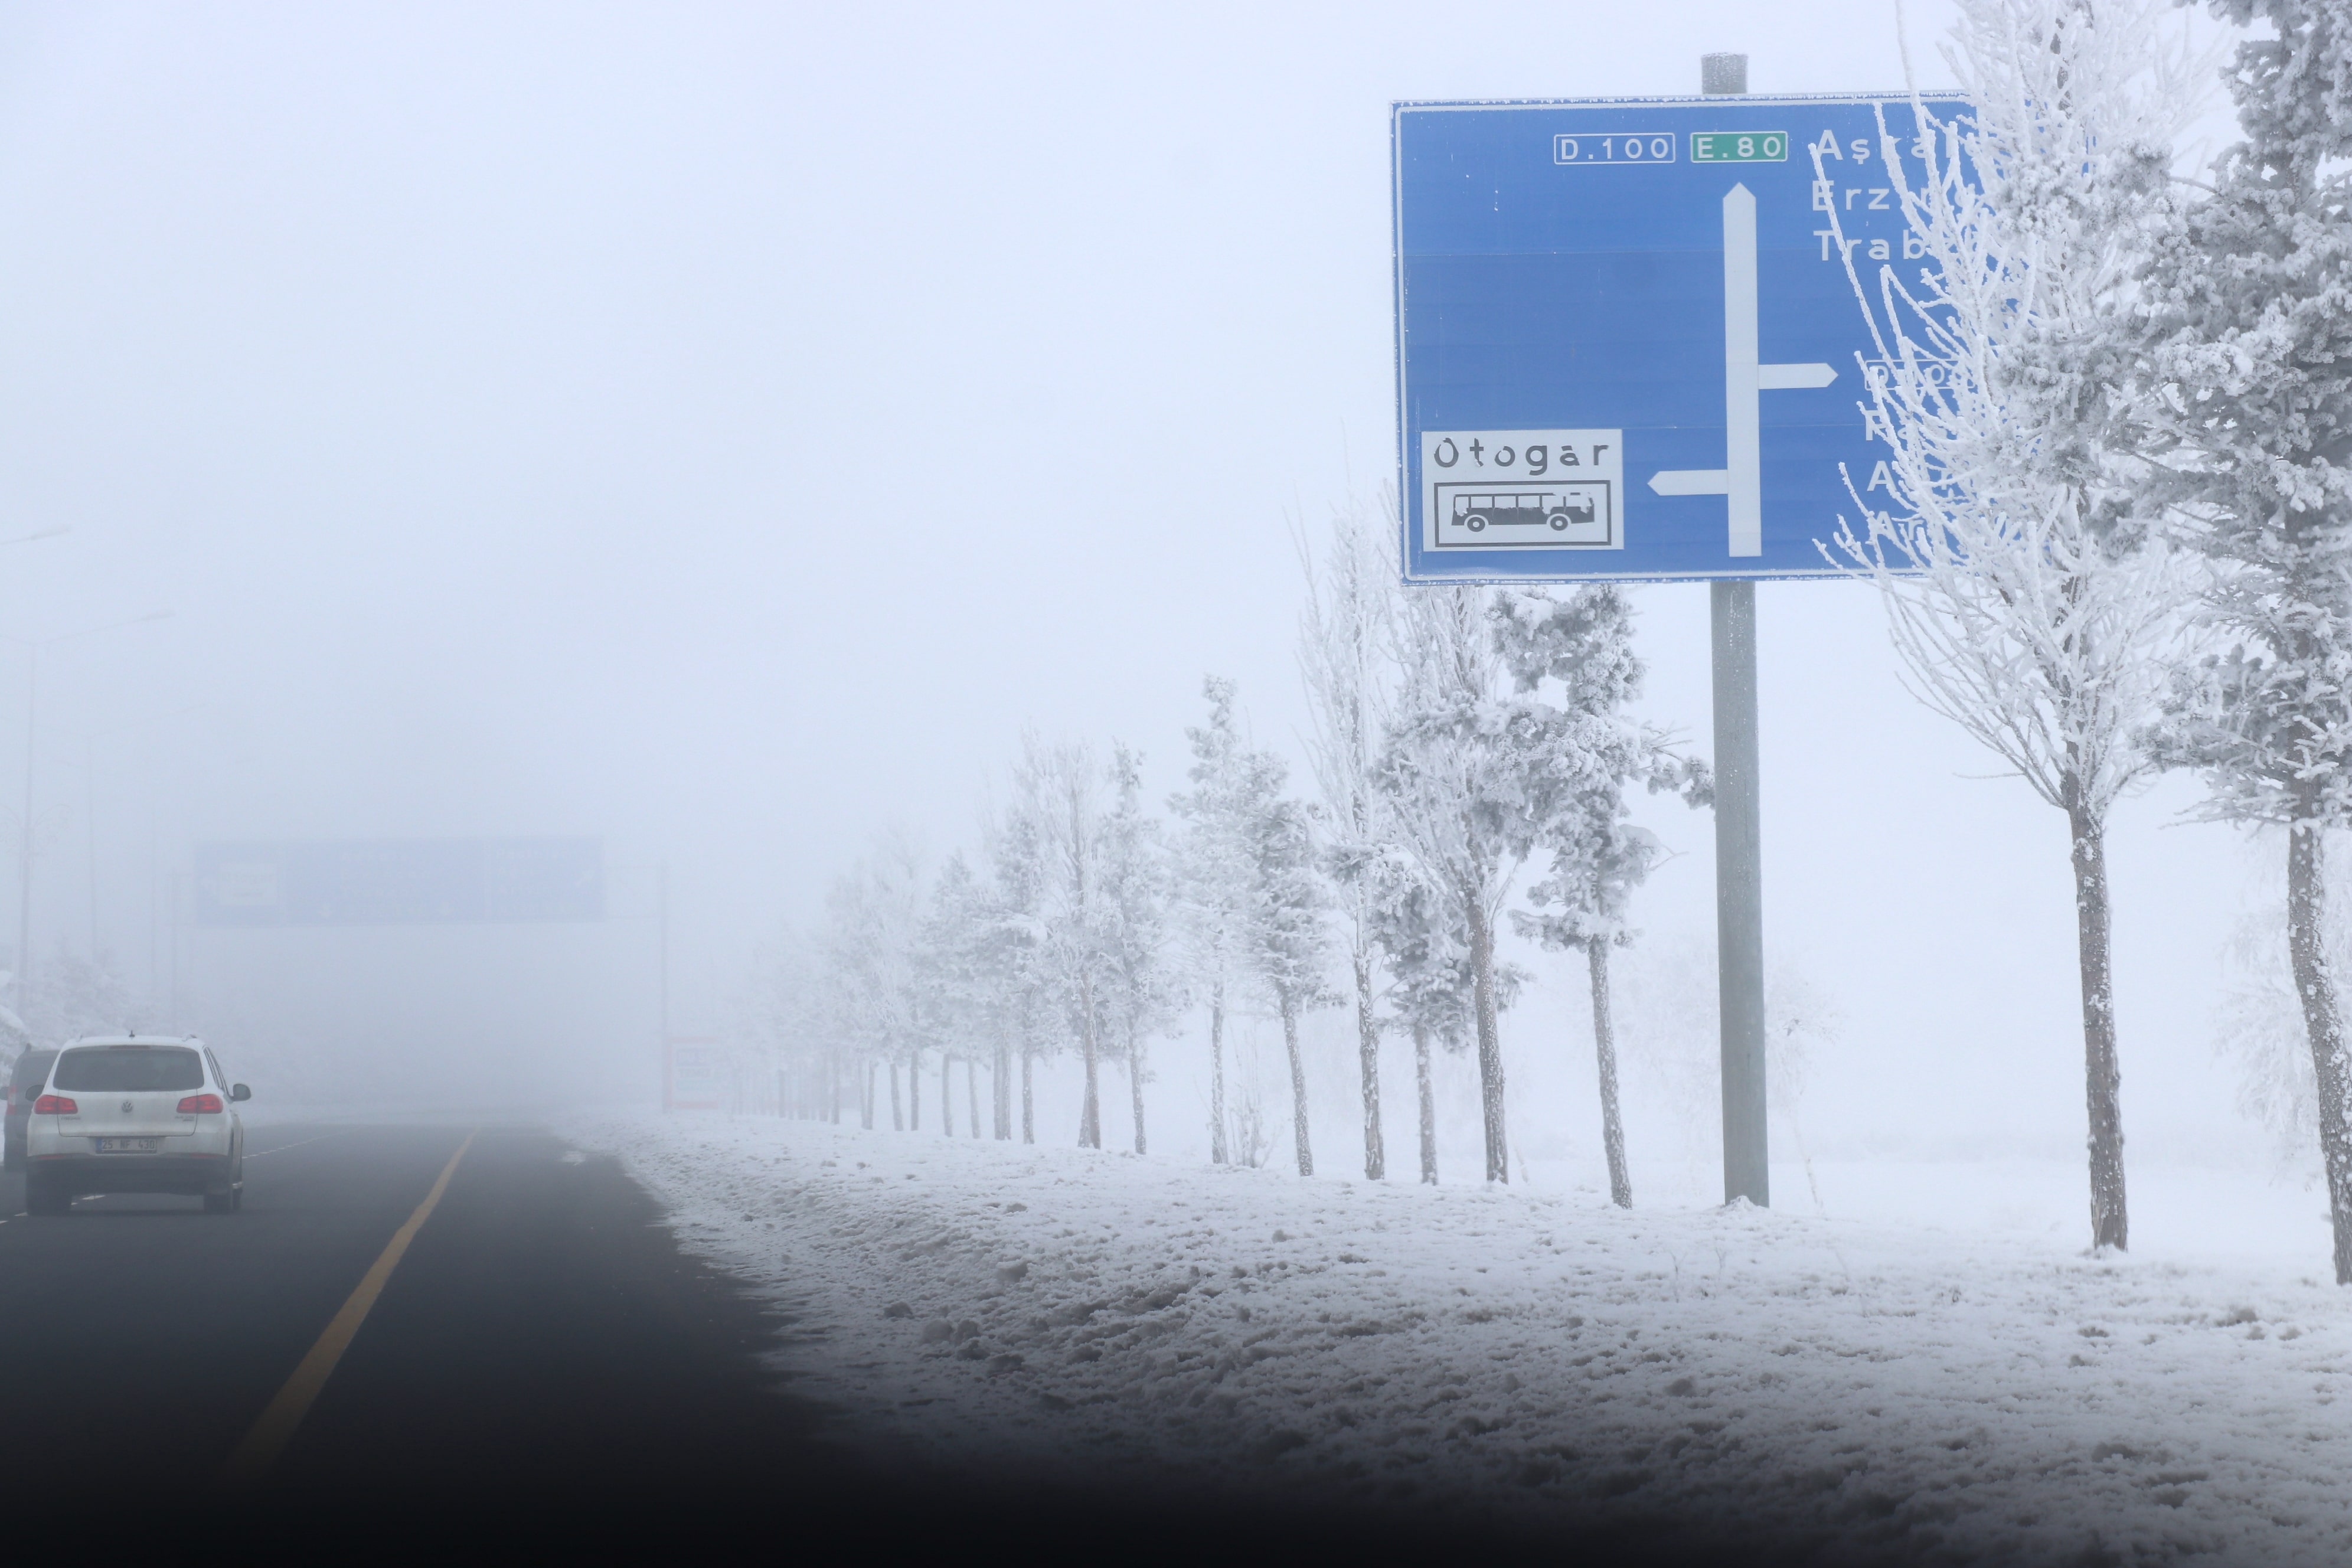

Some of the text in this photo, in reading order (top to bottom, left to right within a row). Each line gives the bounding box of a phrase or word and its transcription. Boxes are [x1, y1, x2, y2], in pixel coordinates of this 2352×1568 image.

[1562, 138, 1669, 160] D.100
[1697, 136, 1782, 159] E.80
[1433, 437, 1609, 476] Otogar
[102, 1139, 113, 1149] 25
[138, 1139, 155, 1149] 430
